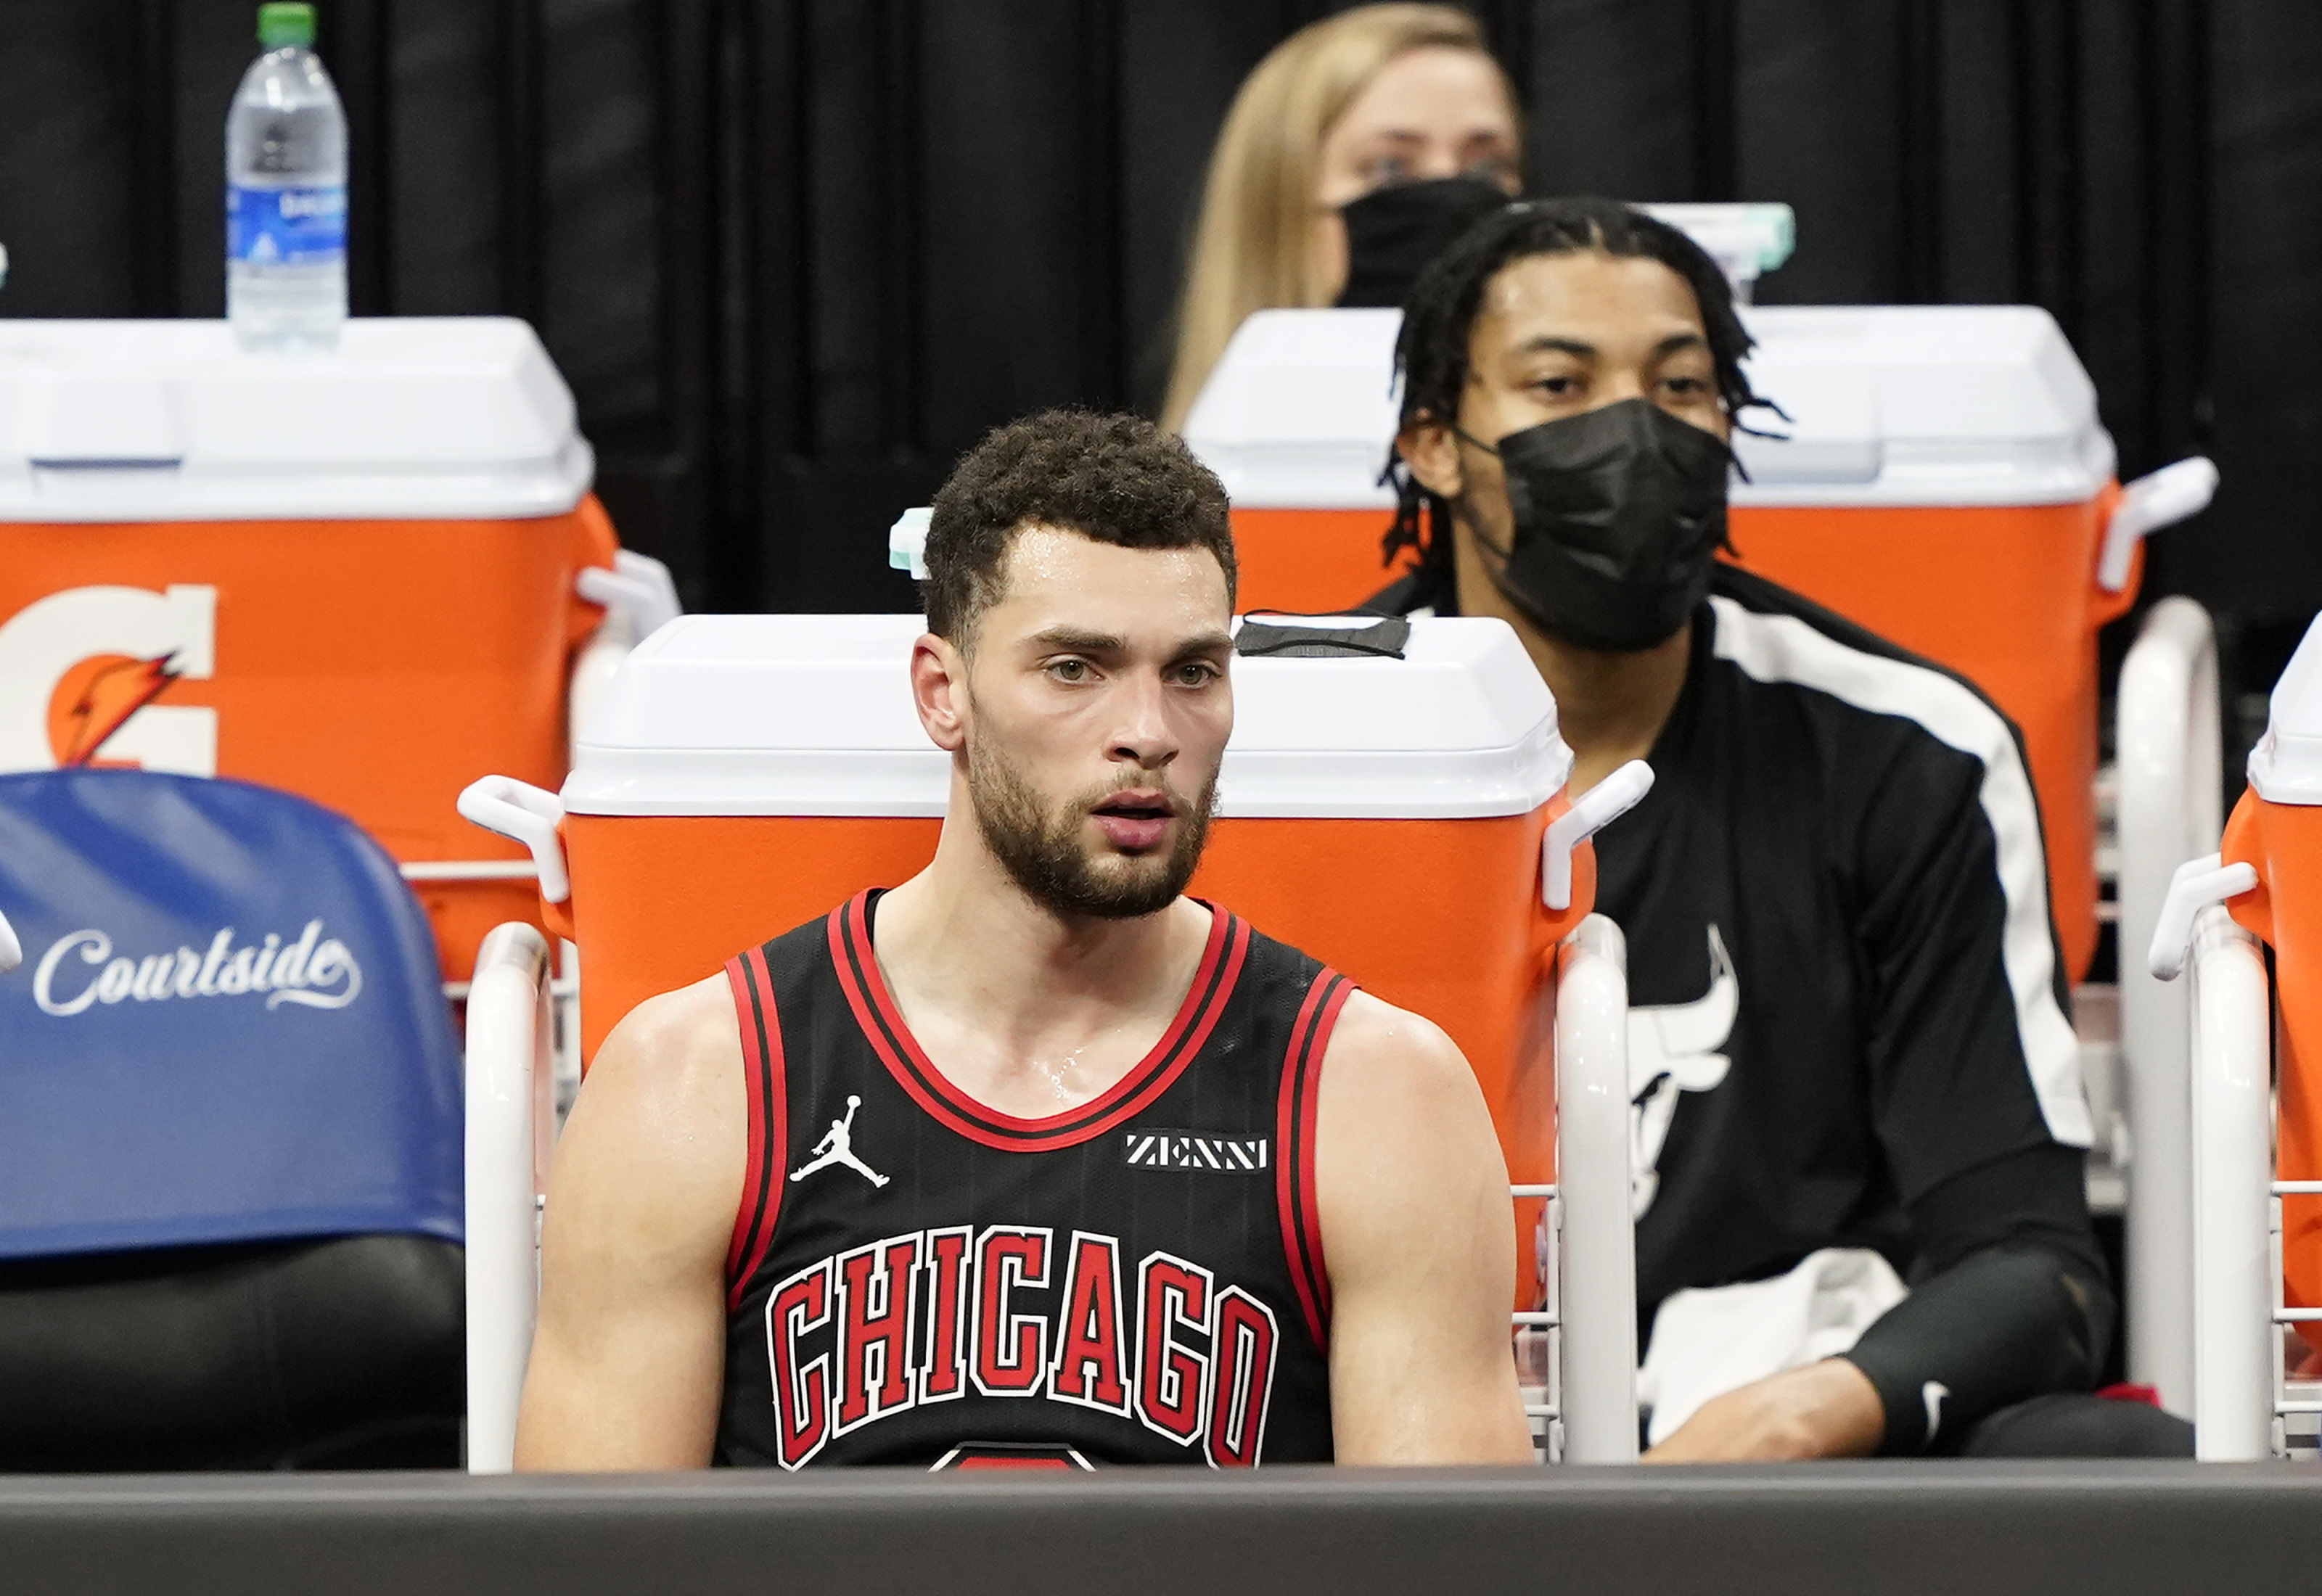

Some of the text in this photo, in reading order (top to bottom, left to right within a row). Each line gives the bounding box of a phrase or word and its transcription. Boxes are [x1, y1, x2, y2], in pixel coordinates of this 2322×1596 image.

[0, 583, 217, 778] G
[33, 918, 361, 1016] Courtside
[1127, 1135, 1267, 1170] ZENNI
[766, 1225, 1279, 1471] CHICAGO
